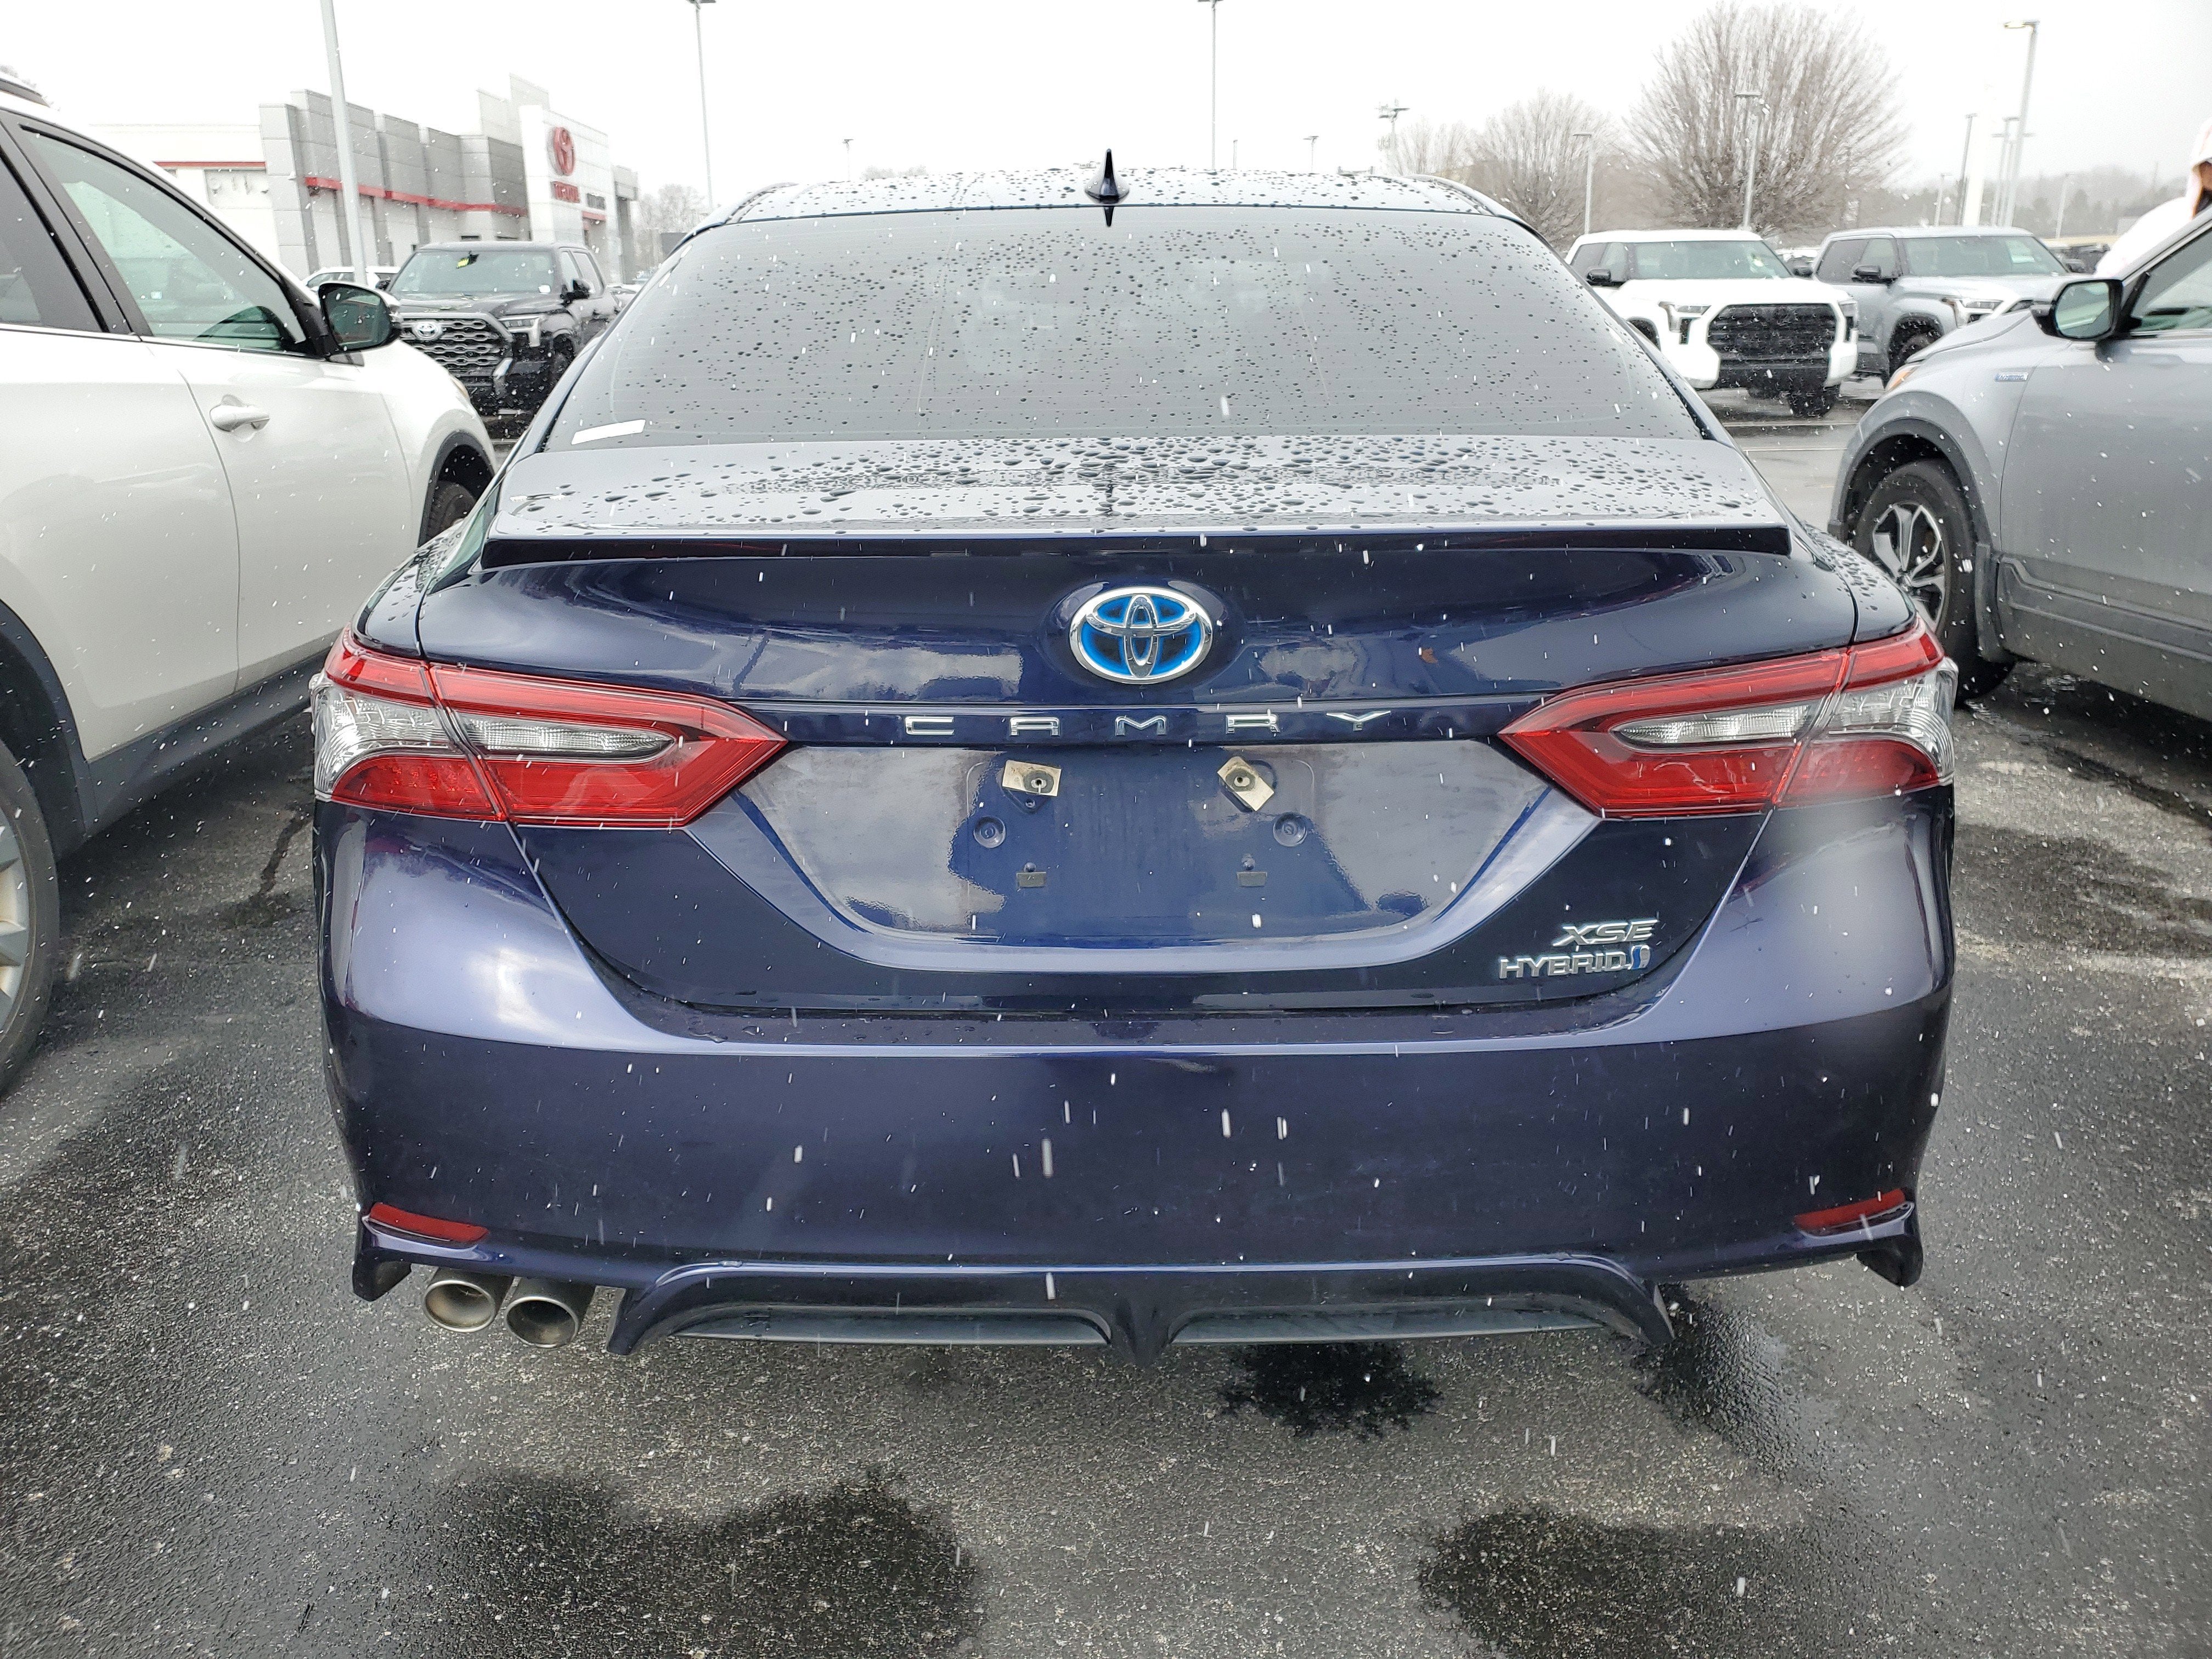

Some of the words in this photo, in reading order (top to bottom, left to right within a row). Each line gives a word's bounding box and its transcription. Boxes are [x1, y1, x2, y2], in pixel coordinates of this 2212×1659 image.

[905, 710, 1391, 736] CAMRY
[1552, 919, 1658, 947] XSE
[1499, 950, 1628, 979] HYBRID
